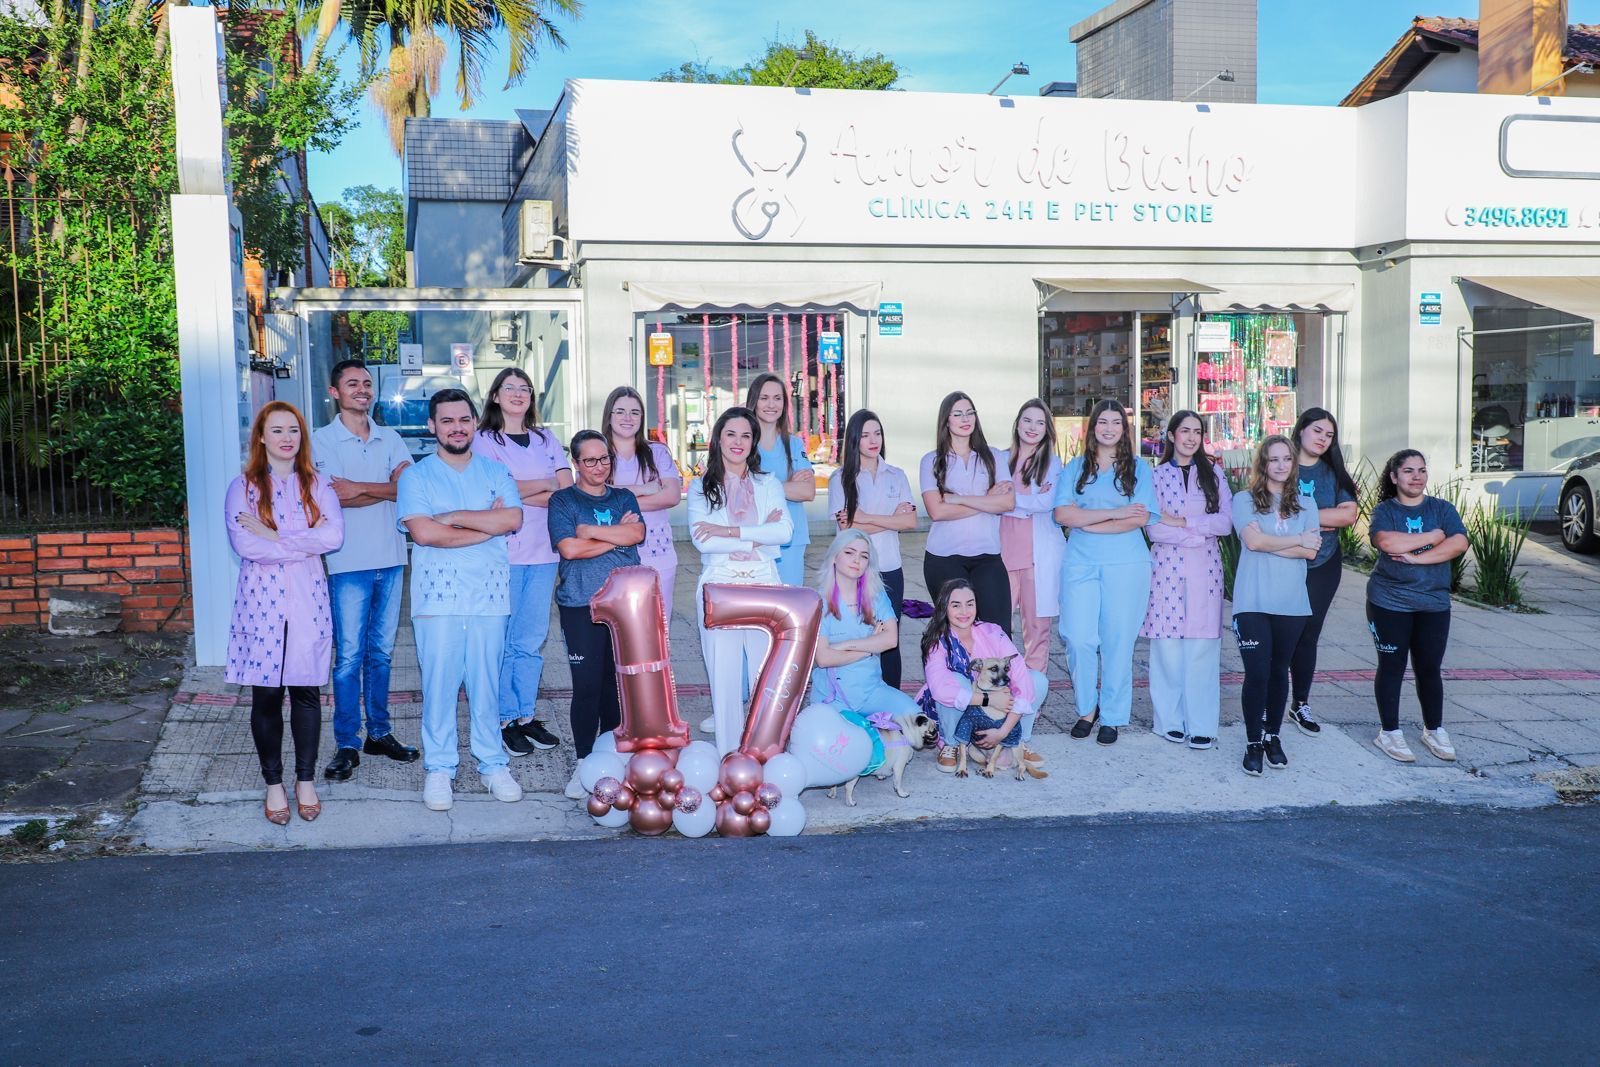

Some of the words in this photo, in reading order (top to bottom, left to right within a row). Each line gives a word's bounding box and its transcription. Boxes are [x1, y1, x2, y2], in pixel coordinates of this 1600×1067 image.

[829, 124, 997, 188] Amor
[1016, 115, 1080, 190] de
[1104, 126, 1256, 197] Bicho
[985, 200, 1034, 221] 24H
[1047, 201, 1060, 221] E
[1074, 202, 1119, 222] PET
[1133, 202, 1214, 223] STORE
[1464, 206, 1569, 228] 3496.8691
